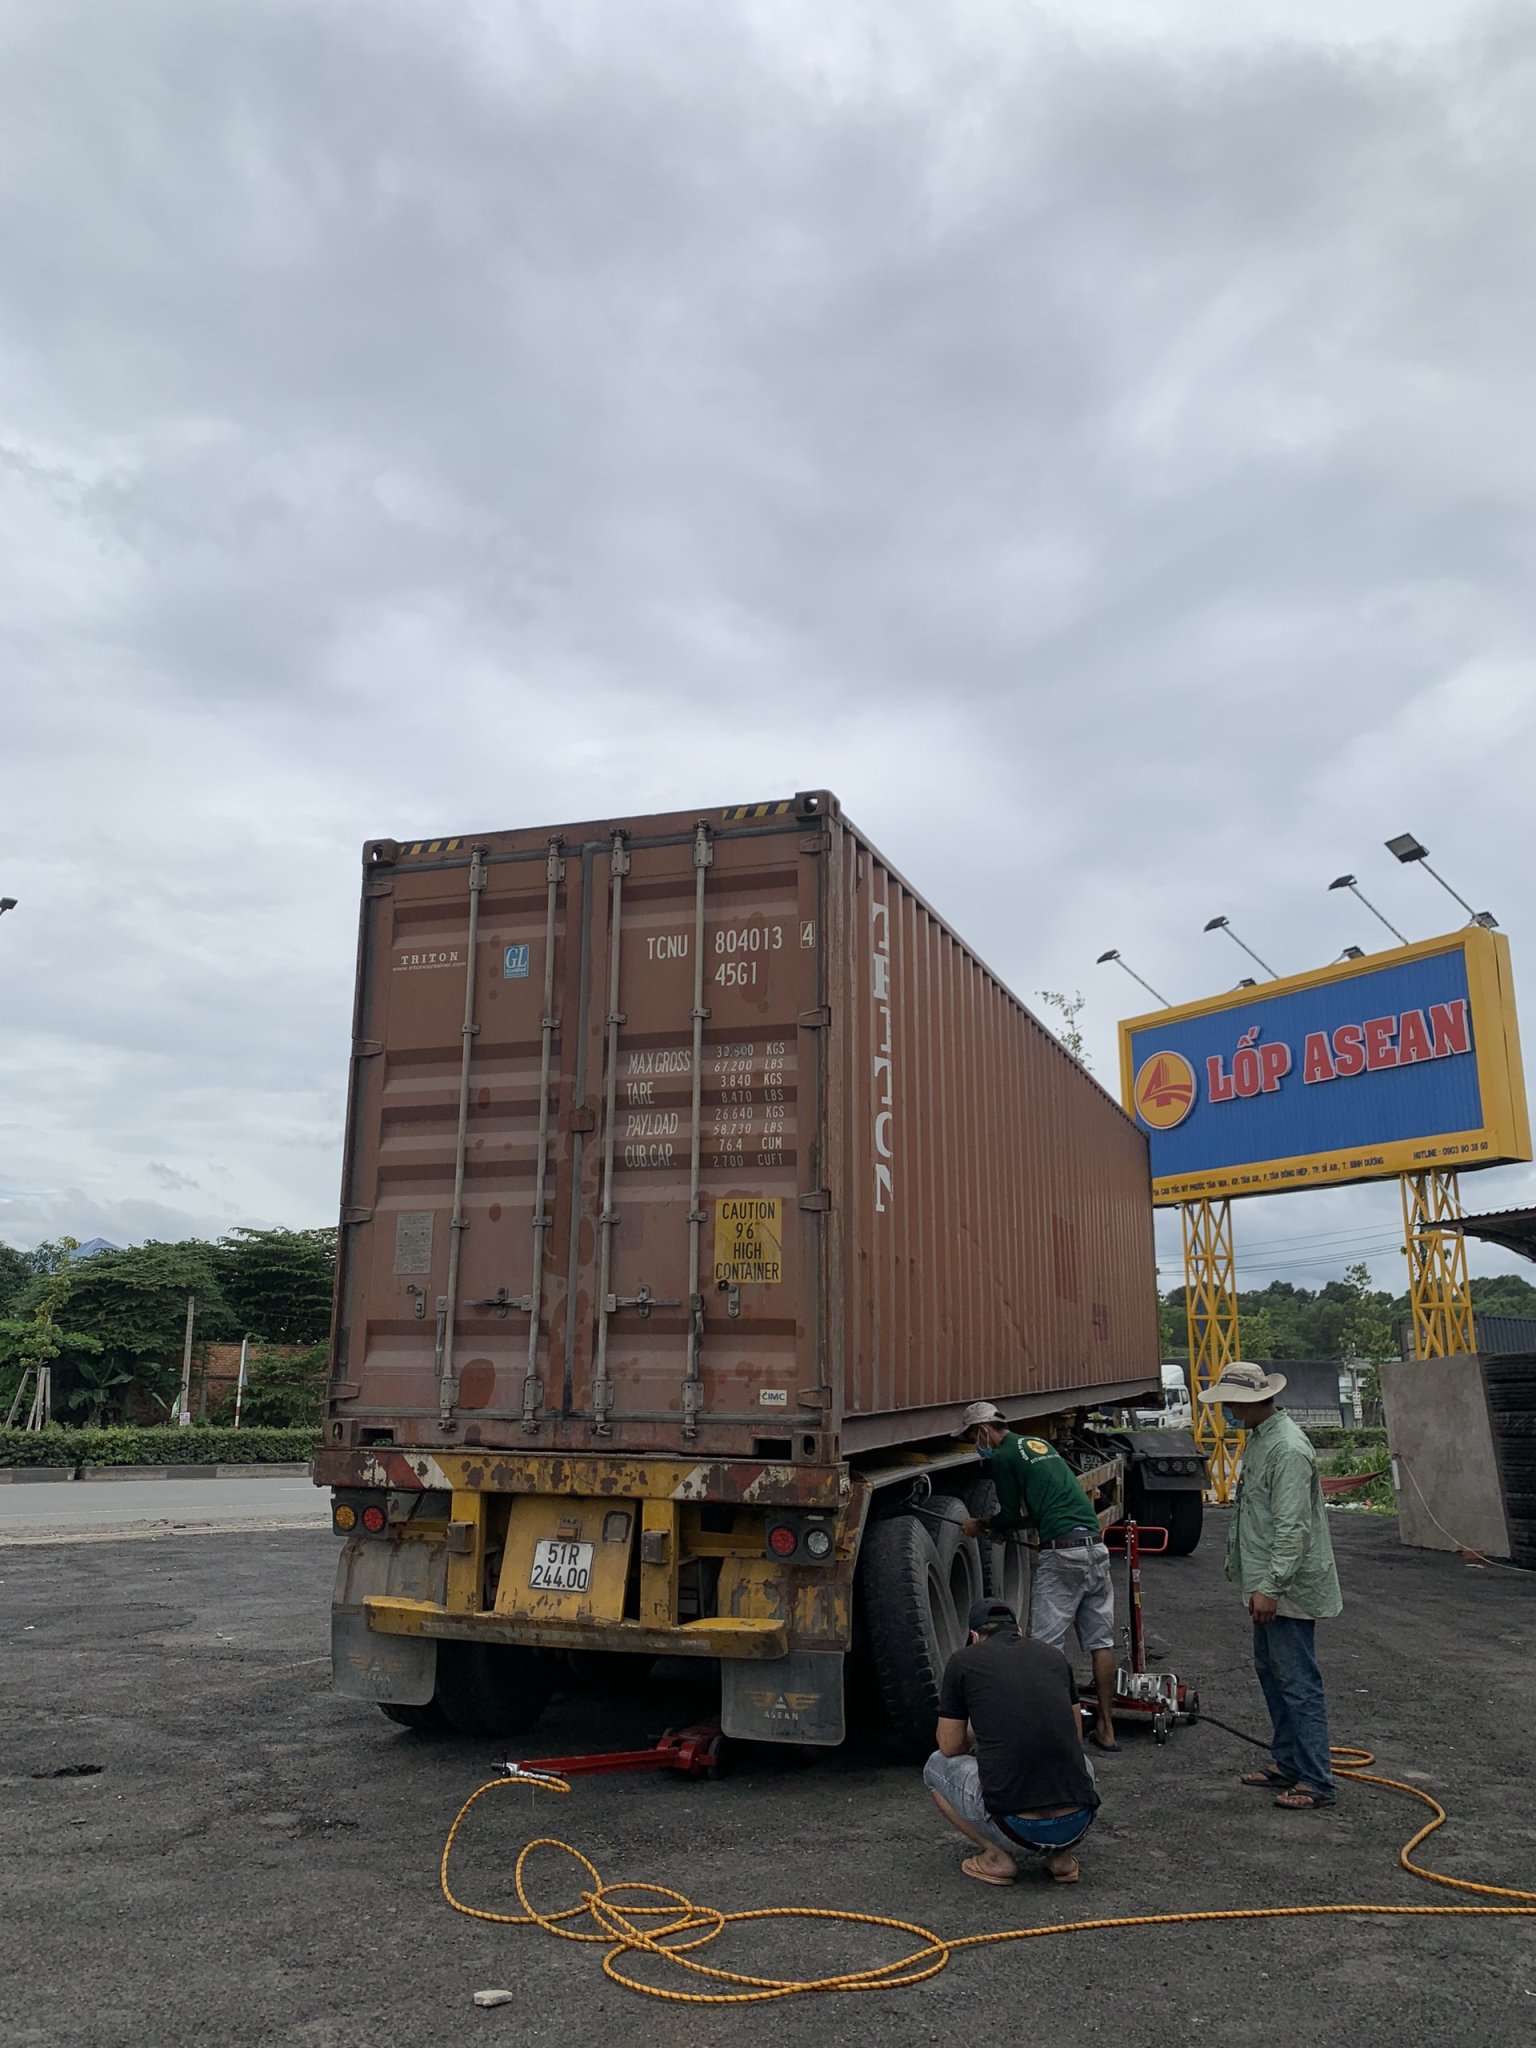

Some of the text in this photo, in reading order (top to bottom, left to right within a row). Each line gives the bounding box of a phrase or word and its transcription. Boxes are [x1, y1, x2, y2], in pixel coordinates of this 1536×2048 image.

[647, 922, 814, 960] TCNU 804013 4
[401, 951, 458, 965] TRITON
[506, 946, 527, 969] GL
[714, 961, 757, 986] 45G1
[766, 1042, 785, 1055] KGS
[1206, 999, 1471, 1103] LỐP ASEAN
[714, 1058, 784, 1073] 67.200 LBS
[720, 1073, 782, 1087] 3.840 KGS
[626, 1082, 655, 1105] TARE
[721, 1089, 784, 1104] 8.470 LBS
[715, 1105, 785, 1121] 26.640 KGS
[626, 1113, 679, 1137] PAYLOAD
[713, 1121, 783, 1136] 58.730 LBS
[719, 1136, 782, 1151] 76.4 CUM
[624, 1143, 677, 1168] CUB.CAP.
[713, 1153, 783, 1168] 2.700 CUFT
[722, 1202, 775, 1219] CAUTION
[733, 1242, 761, 1259] HIGH
[715, 1262, 779, 1280] CONTAINER
[761, 1391, 785, 1401] CIMC
[548, 1543, 580, 1566] 51R
[532, 1564, 588, 1590] 244.00
[763, 1710, 799, 1721] ASEAN
